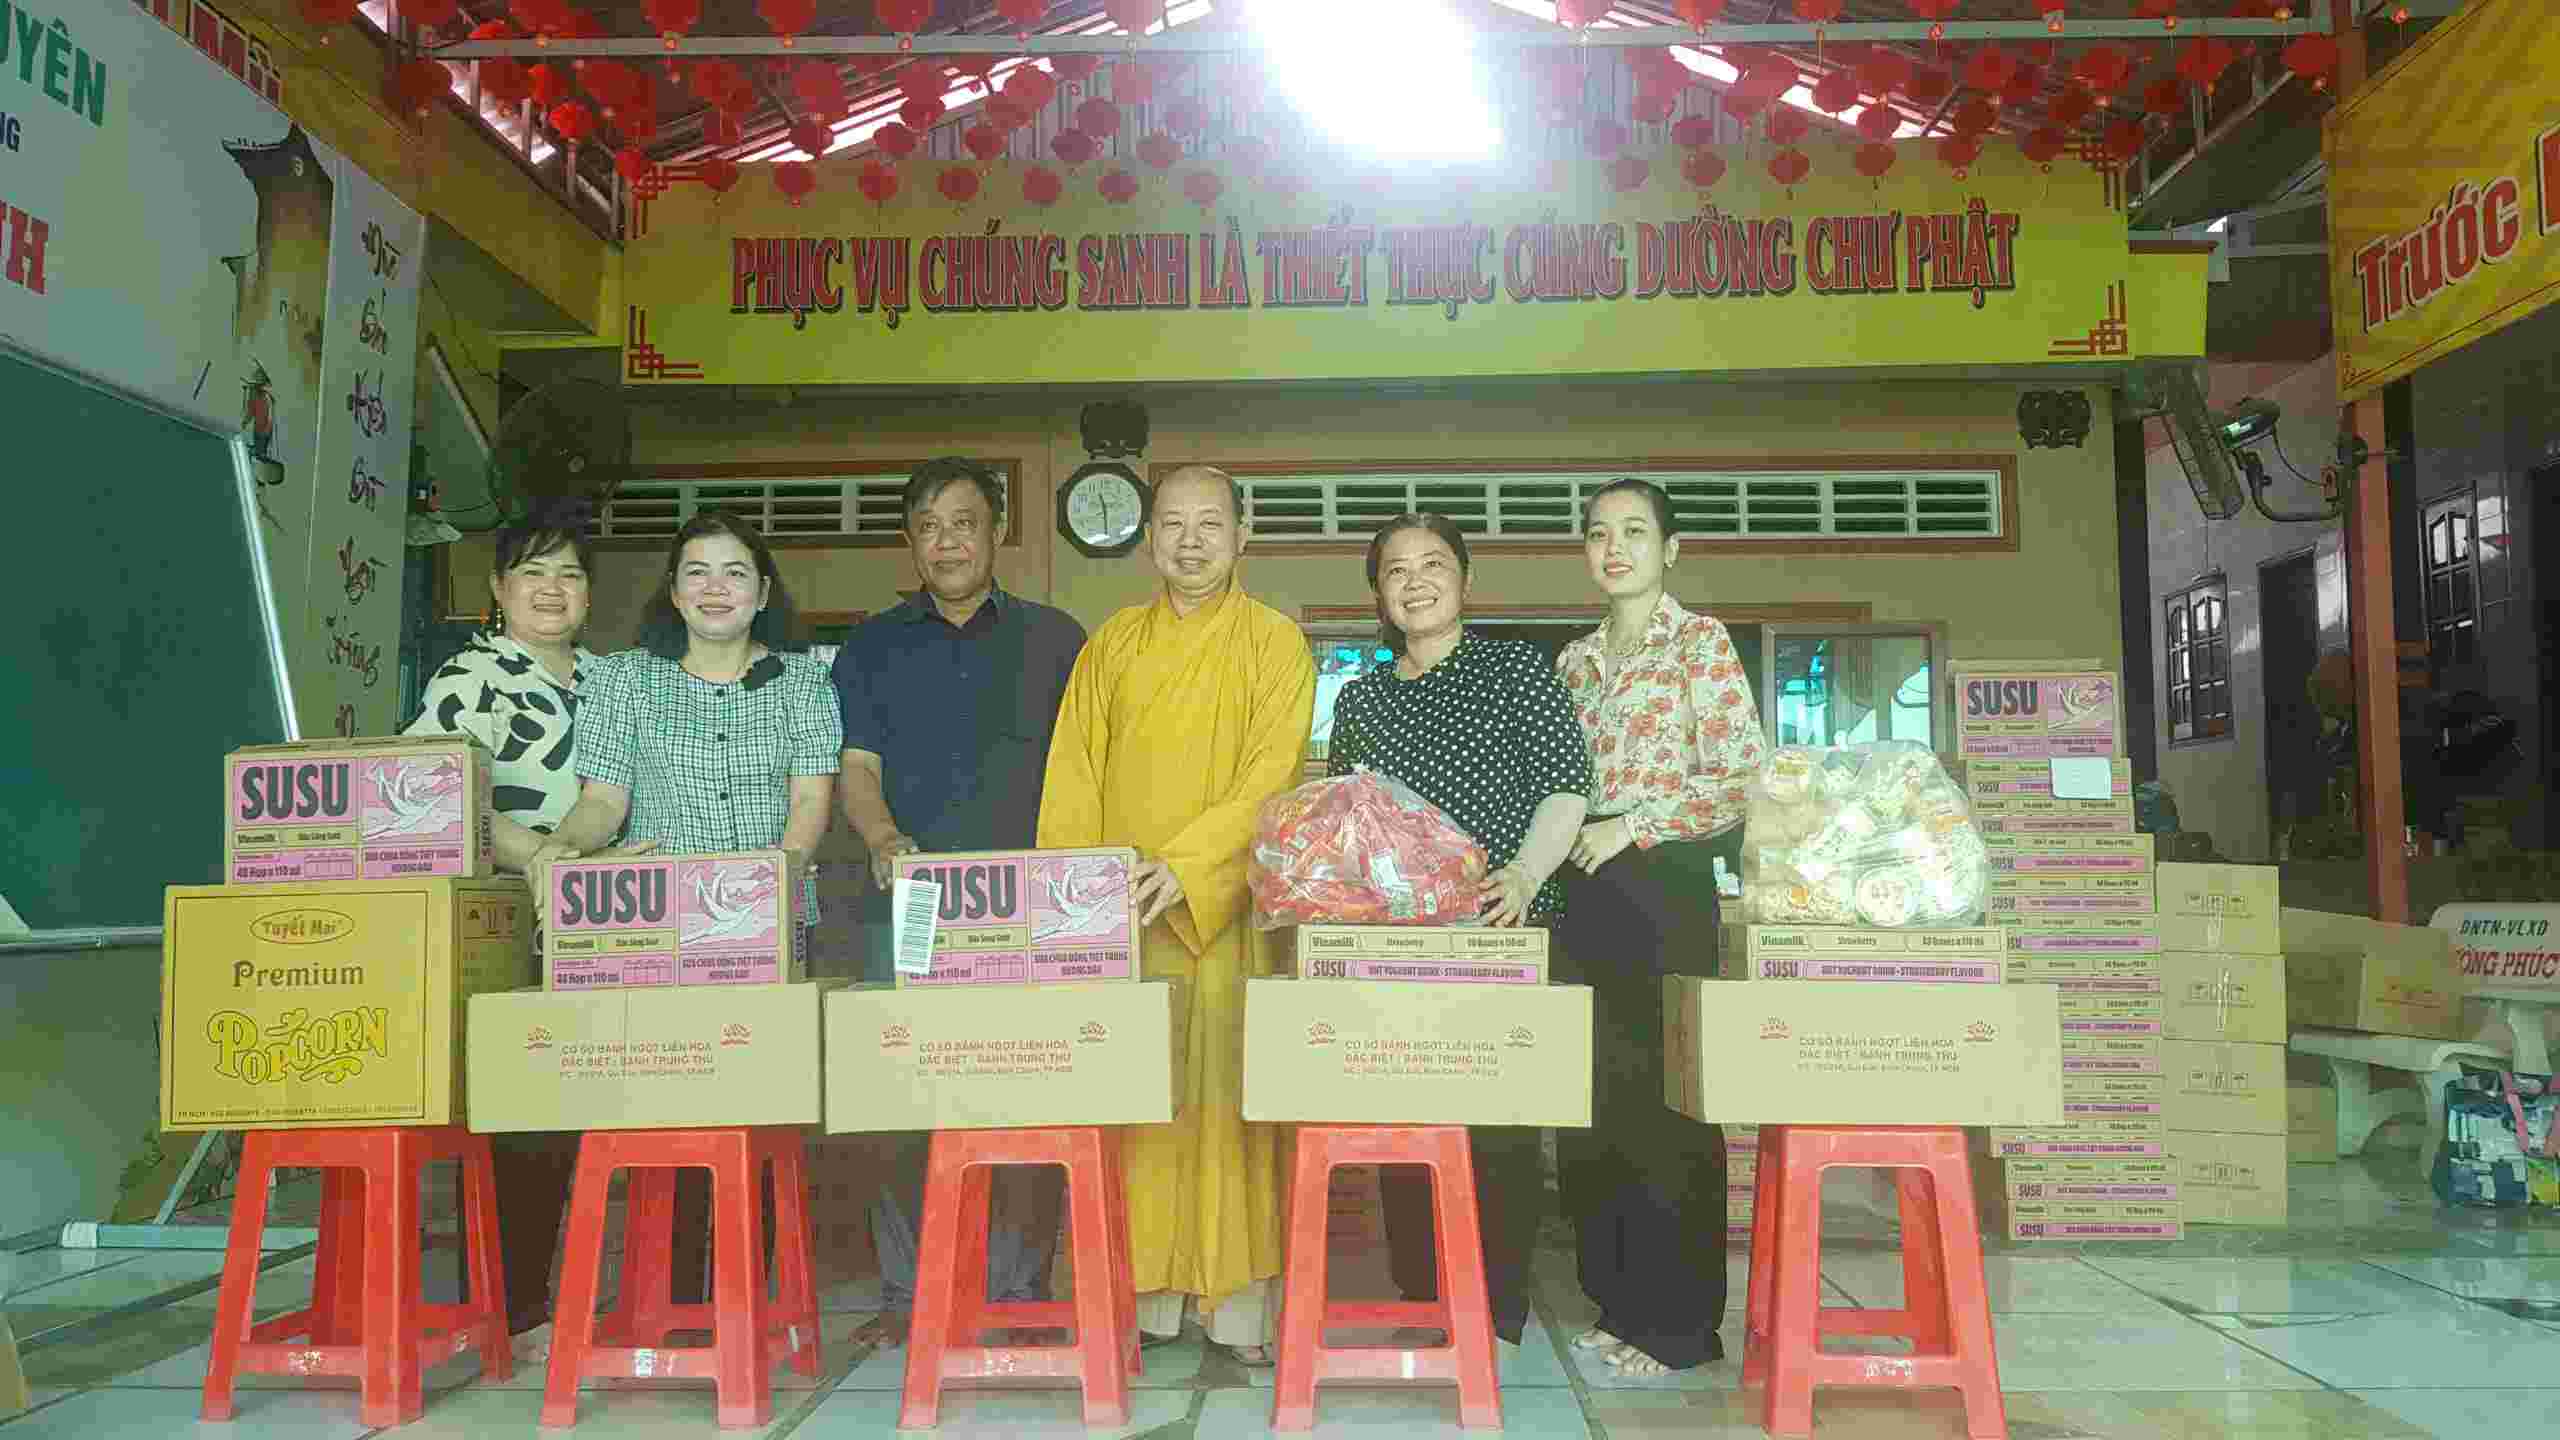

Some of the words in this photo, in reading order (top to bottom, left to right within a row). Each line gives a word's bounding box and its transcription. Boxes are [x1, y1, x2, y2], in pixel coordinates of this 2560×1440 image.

[731, 233, 845, 330] PHỤC
[847, 233, 912, 330] VỤ
[919, 217, 1069, 313] CHÚNG
[1076, 231, 1191, 312] SANH
[1198, 216, 1251, 310] LÀ
[1256, 203, 1373, 308] THIẾT
[1382, 221, 1497, 320] THỰC
[1503, 208, 1628, 302] CÚNG
[1634, 204, 1797, 298] DƯỜNG
[1806, 211, 1902, 293] CHƯ
[1906, 198, 2021, 308] PHẬT
[2353, 175, 2522, 334] Trước
[1967, 680, 2039, 716] SUSU
[240, 763, 350, 820] SUSU
[561, 867, 667, 925] SUSU
[232, 959, 365, 988] Premium
[1312, 960, 1347, 978] SUSU
[1763, 960, 1799, 978] SUSU
